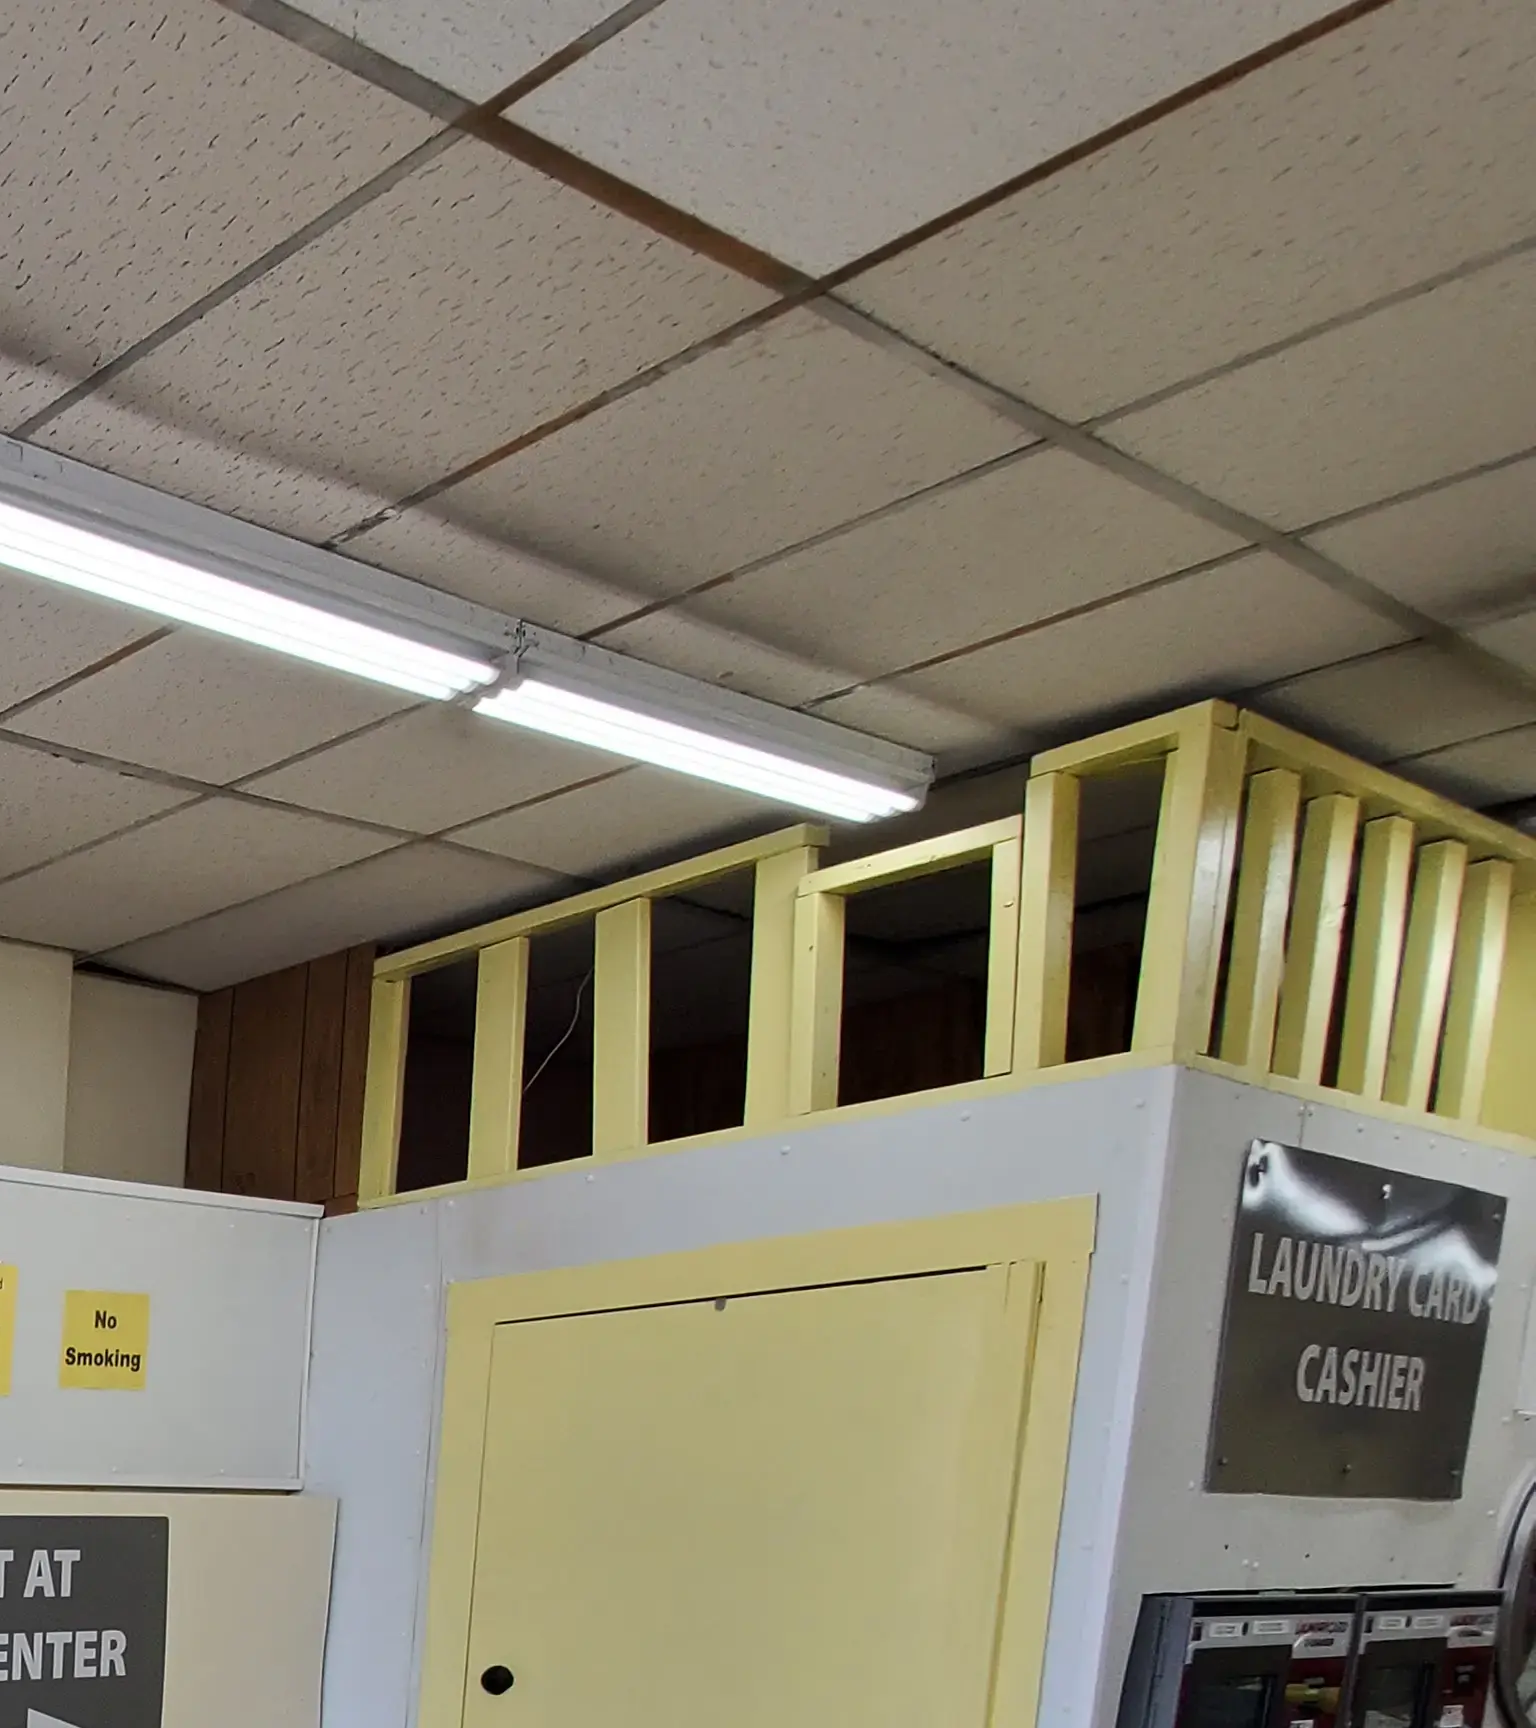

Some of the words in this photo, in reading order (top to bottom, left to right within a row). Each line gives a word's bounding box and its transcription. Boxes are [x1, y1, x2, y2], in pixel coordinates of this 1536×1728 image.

[1248, 1231, 1407, 1314] LAUNDRY
[1408, 1260, 1480, 1325] CARD
[94, 1310, 118, 1330] No
[64, 1346, 142, 1373] Smoking
[1295, 1343, 1426, 1412] CASHIER
[22, 1549, 82, 1599] AT
